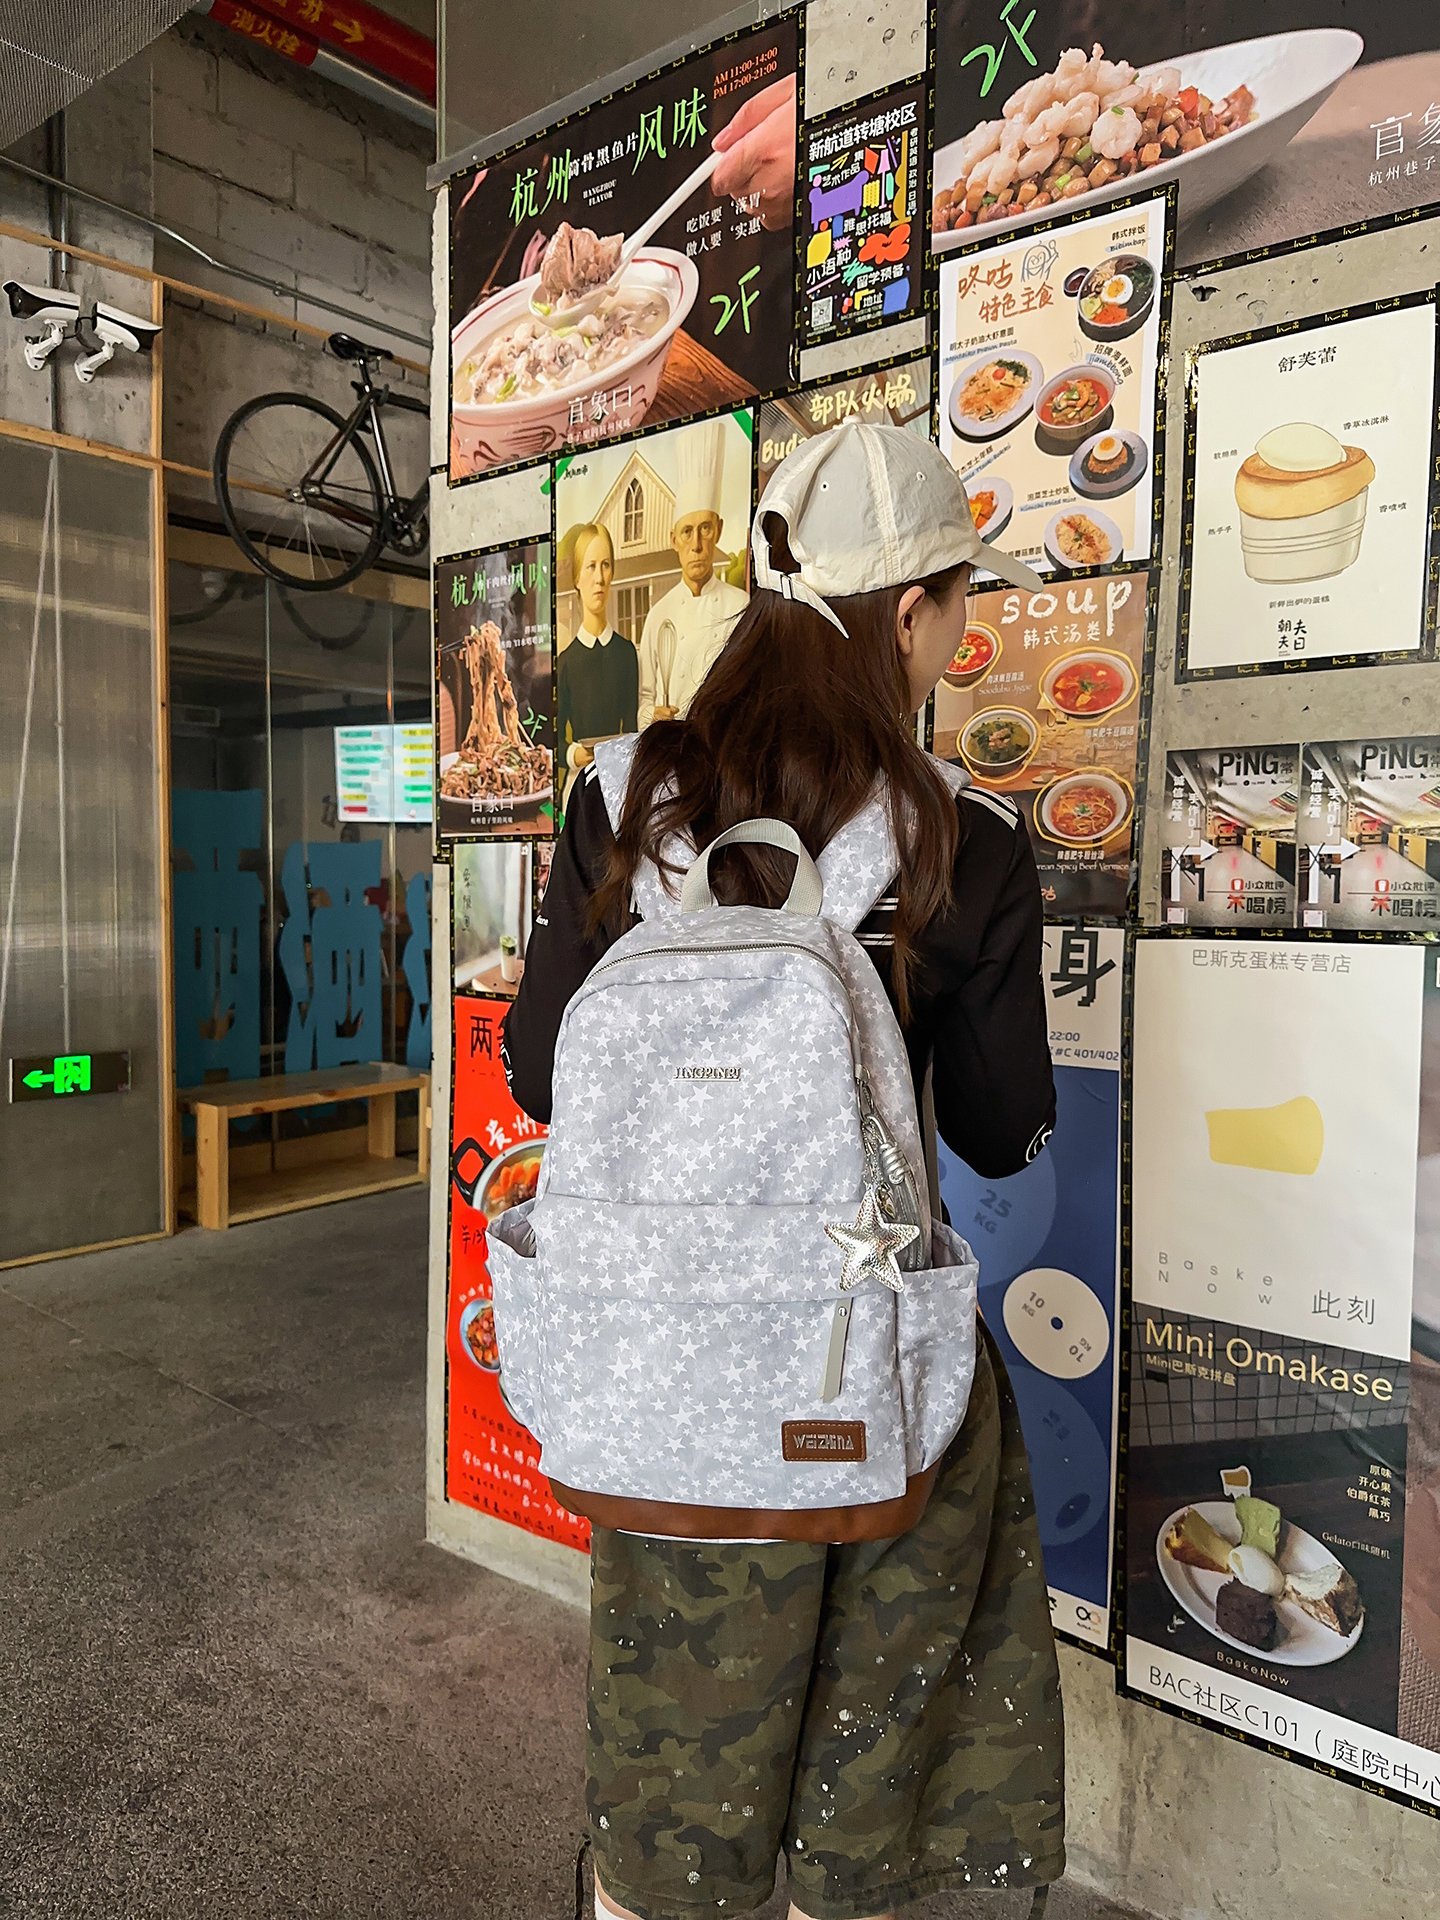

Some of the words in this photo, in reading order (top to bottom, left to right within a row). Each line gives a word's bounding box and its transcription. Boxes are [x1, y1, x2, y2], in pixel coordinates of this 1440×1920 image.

[713, 70, 729, 87] AM
[730, 47, 778, 79] 11:00-14:00
[713, 84, 727, 99] PM
[729, 60, 777, 92] 17:00-21:00
[808, 101, 917, 162] 新航道转塘校区
[509, 149, 571, 227] 杭州
[631, 87, 708, 176] 风味
[843, 210, 892, 236] 雅思托福
[806, 247, 852, 286] 小语种
[857, 263, 904, 290] 留学预备
[709, 265, 761, 335] 2F
[978, 281, 1055, 324] 特色主食
[1278, 346, 1337, 373] 舒芙蕾
[809, 373, 917, 426] 部队火锅
[761, 433, 807, 463] Bud
[1000, 580, 1133, 637] soup
[1023, 620, 1101, 650] 韩式汤类
[1244, 881, 1284, 891] 小众批评
[1391, 880, 1435, 892] 小众批评
[1191, 949, 1351, 974] 巴斯克蛋糕专营店
[1073, 1049, 1120, 1061] 401/402
[980, 1189, 1012, 1218] 25
[974, 1211, 997, 1234] KG
[1021, 1303, 1035, 1318] KG
[1028, 1291, 1045, 1309] 10
[1312, 1289, 1375, 1325] 此刻
[1145, 1318, 1214, 1360] Mini
[1226, 1337, 1393, 1402] Omakase
[1358, 1475, 1392, 1494] 开心果
[1369, 1464, 1392, 1479] 原味
